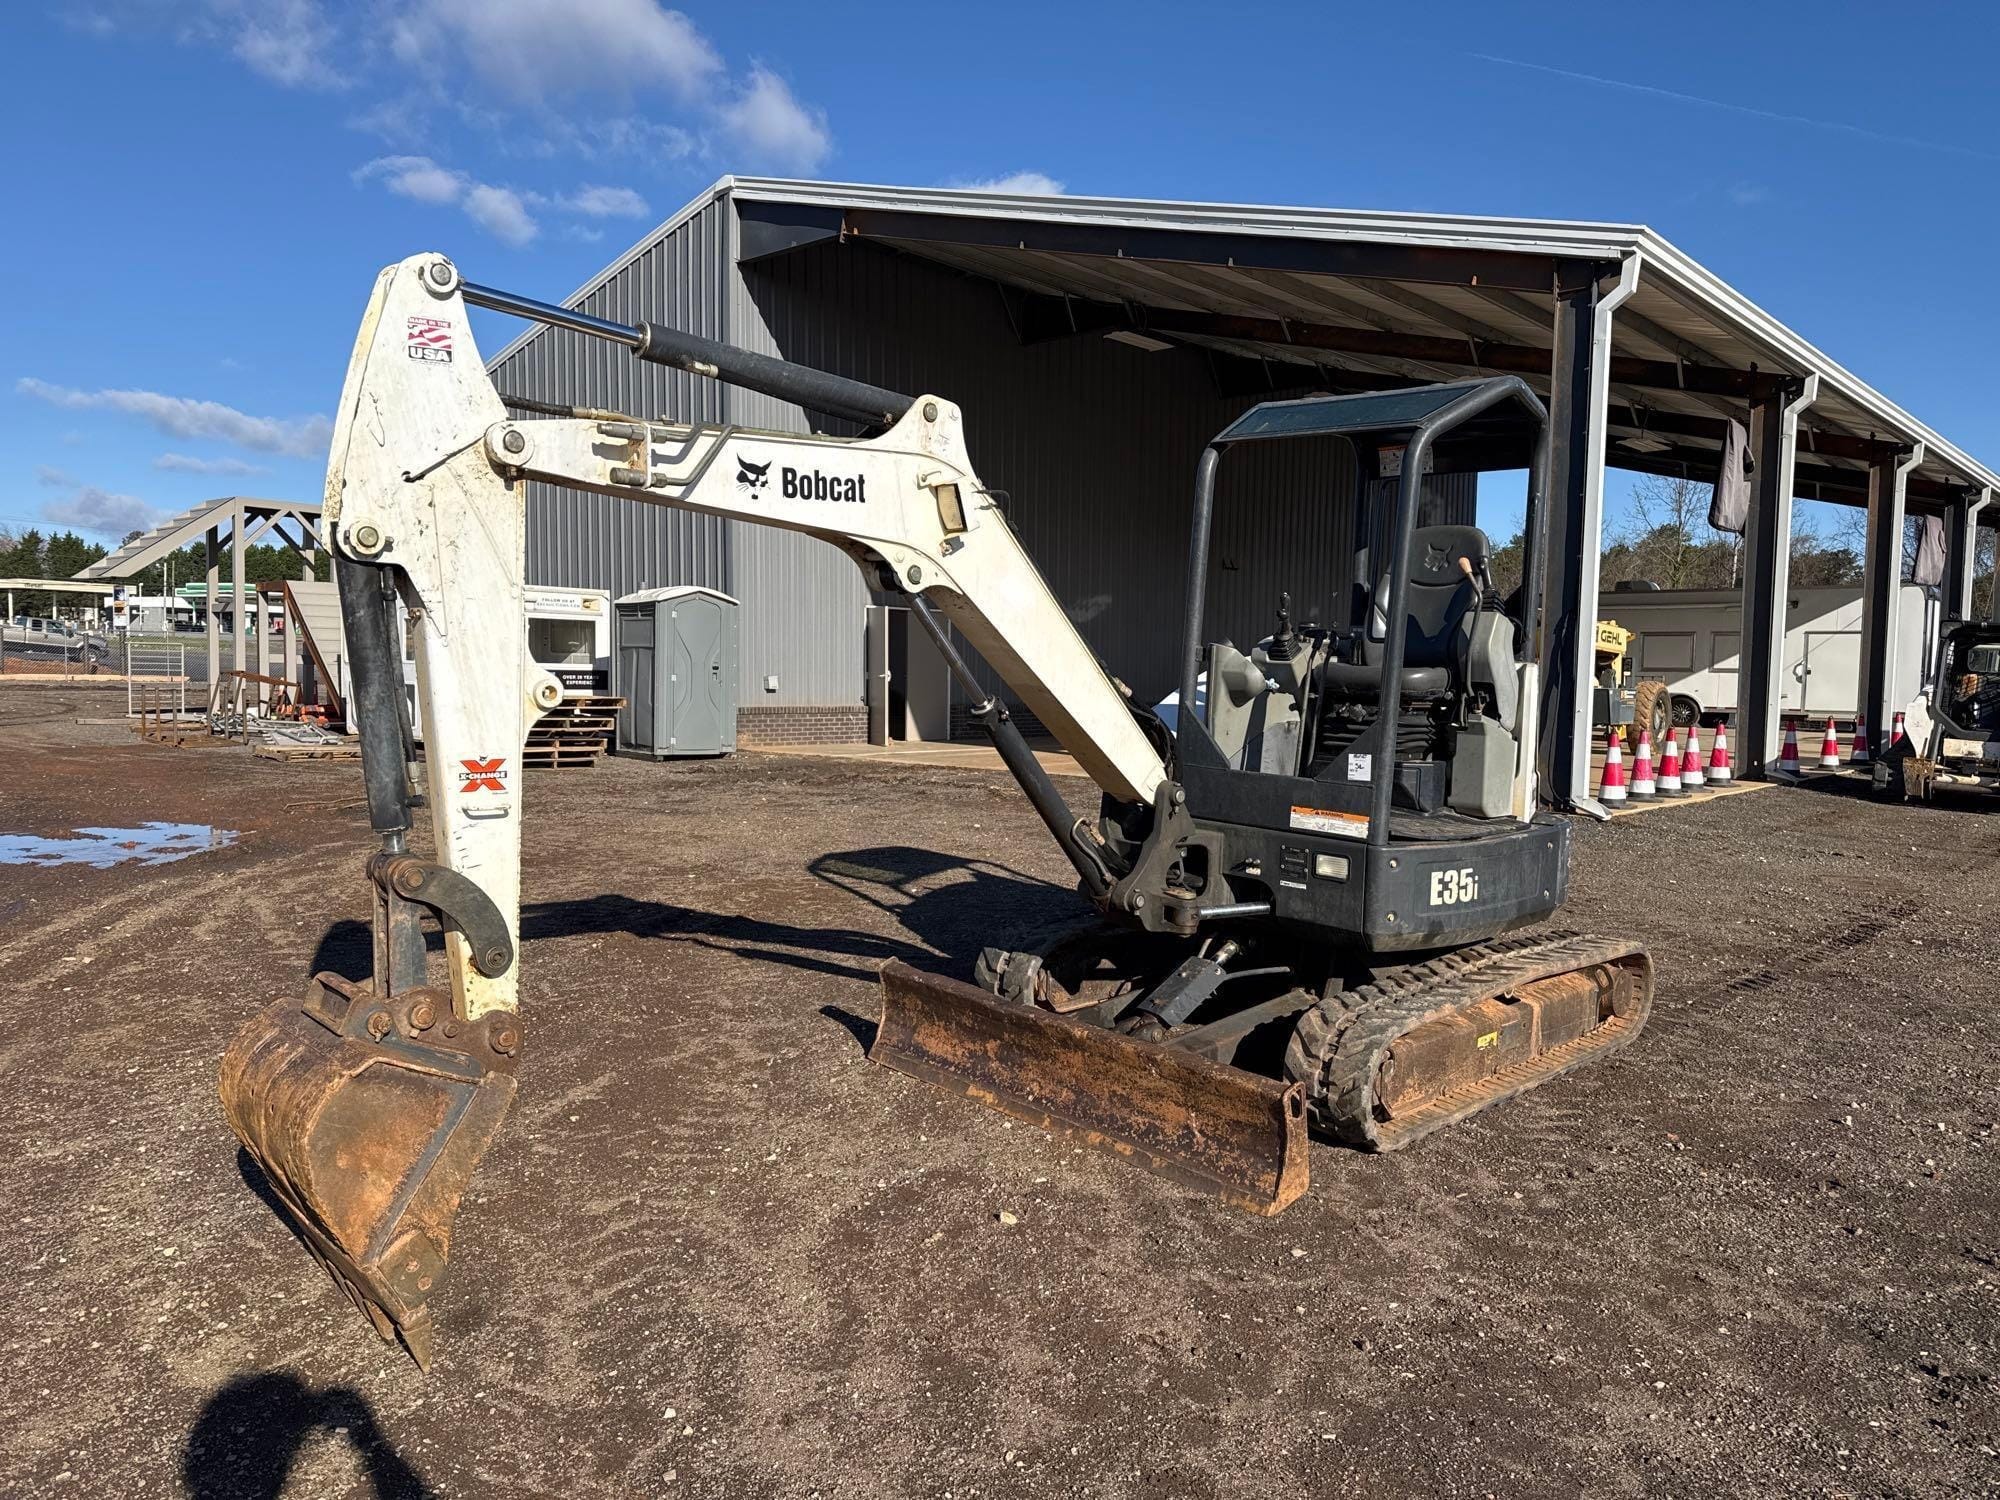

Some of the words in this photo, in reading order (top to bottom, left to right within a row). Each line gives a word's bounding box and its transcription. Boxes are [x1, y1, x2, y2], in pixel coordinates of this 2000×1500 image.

[409, 346, 451, 361] USA
[782, 467, 865, 503] Bobcat
[1601, 629, 1622, 646] GEHL
[459, 771, 507, 781] X-CHANGE
[1320, 811, 1344, 819] WARNING
[1430, 868, 1478, 905] E35i
